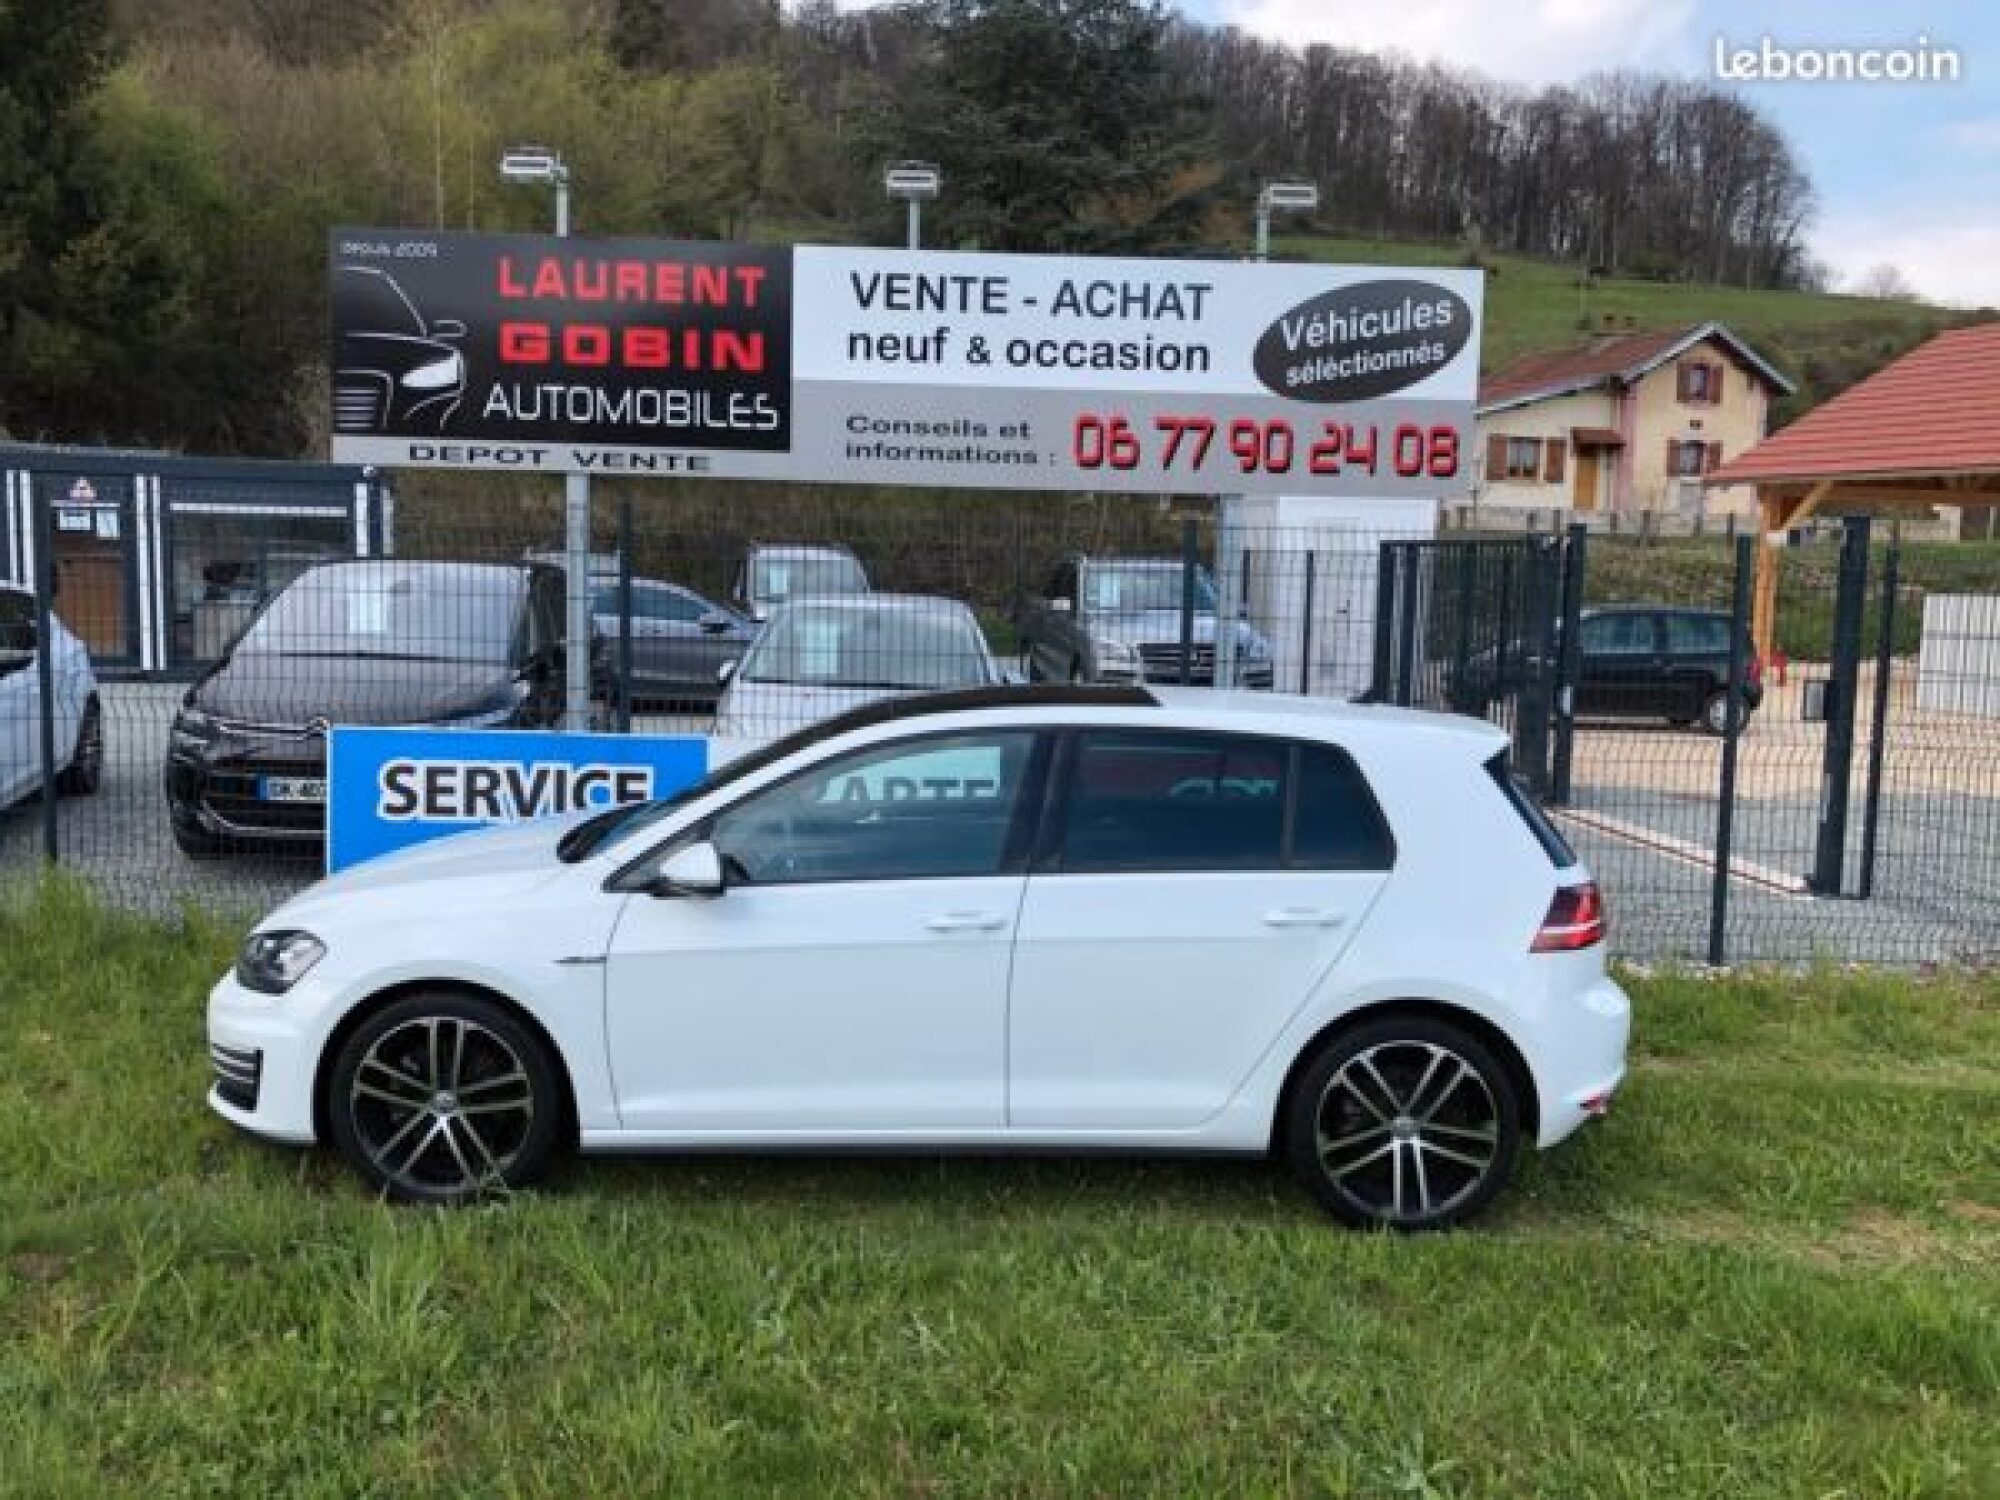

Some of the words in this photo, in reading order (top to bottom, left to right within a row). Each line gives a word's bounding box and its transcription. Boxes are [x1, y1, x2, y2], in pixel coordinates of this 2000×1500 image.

[499, 257, 766, 307] LAURENT
[850, 271, 1011, 314] VENTE
[1050, 280, 1213, 321] ACHAT
[500, 322, 765, 373] GOBIN
[1281, 297, 1453, 350] Véhicules
[848, 326, 950, 363] neuf
[966, 335, 992, 364] &
[1006, 333, 1211, 372] occasion
[483, 384, 778, 430] AUTOMOBILES
[846, 416, 988, 438] Conseils
[1000, 421, 1031, 440] et
[409, 444, 548, 465] DEPOT
[572, 450, 713, 471] VENTE
[846, 441, 1038, 464] informations
[1074, 416, 1141, 470] 06
[1155, 416, 1217, 471] 77
[1229, 419, 1296, 474] 90
[1309, 421, 1379, 477] 24
[1393, 423, 1460, 478] 08
[382, 763, 650, 818] SERVICE
